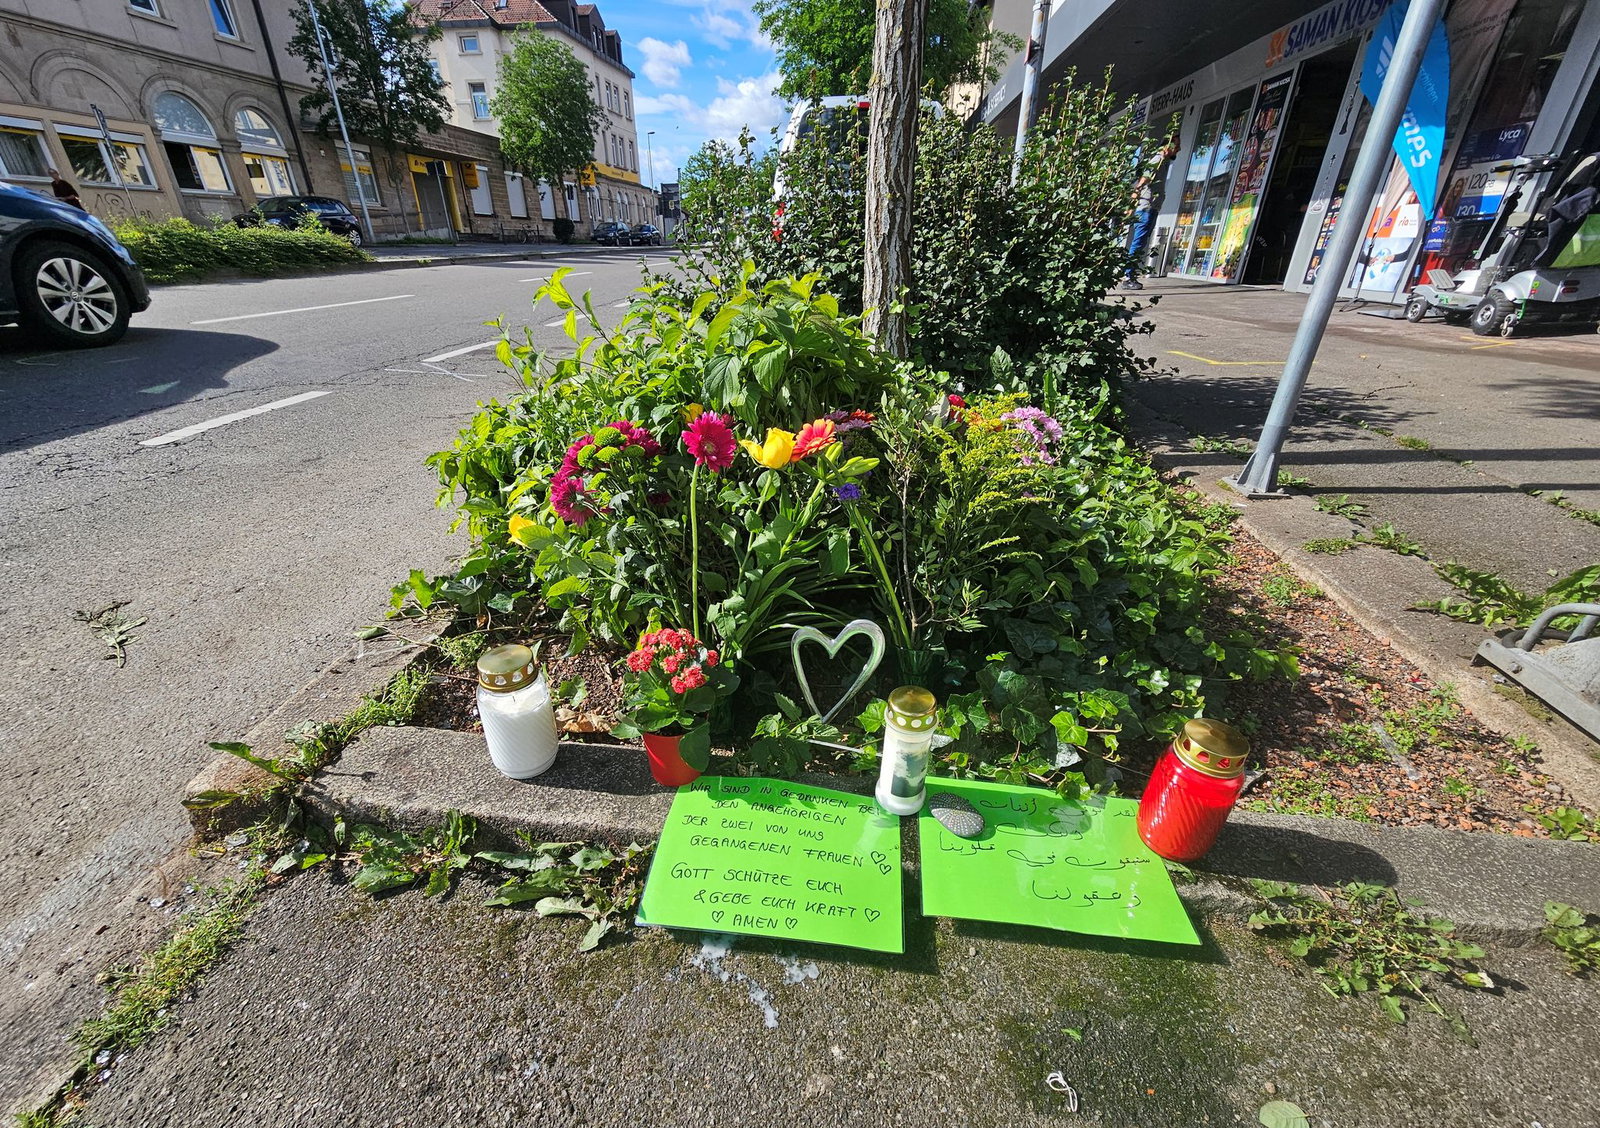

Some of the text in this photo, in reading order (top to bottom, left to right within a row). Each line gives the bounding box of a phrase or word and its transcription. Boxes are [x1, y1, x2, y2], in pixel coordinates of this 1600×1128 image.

[1284, 3, 1343, 58] SAMAN
[1499, 128, 1521, 142] Lyca
[690, 782, 711, 794] WIR
[721, 785, 751, 794] SIND
[760, 786, 772, 794] IN
[781, 788, 849, 809] GEDANKEN
[711, 799, 847, 826] DEN ANGEHÖRIGEN
[682, 814, 824, 841] DER ZWEI VON UNS
[690, 834, 864, 868] GEGANGENEN FRAUEN
[723, 868, 792, 887] SCHÜTZE
[806, 879, 843, 896] EUCH
[761, 896, 796, 910] EUCH
[805, 902, 857, 919] KRAFT
[733, 915, 778, 929] AMEN
